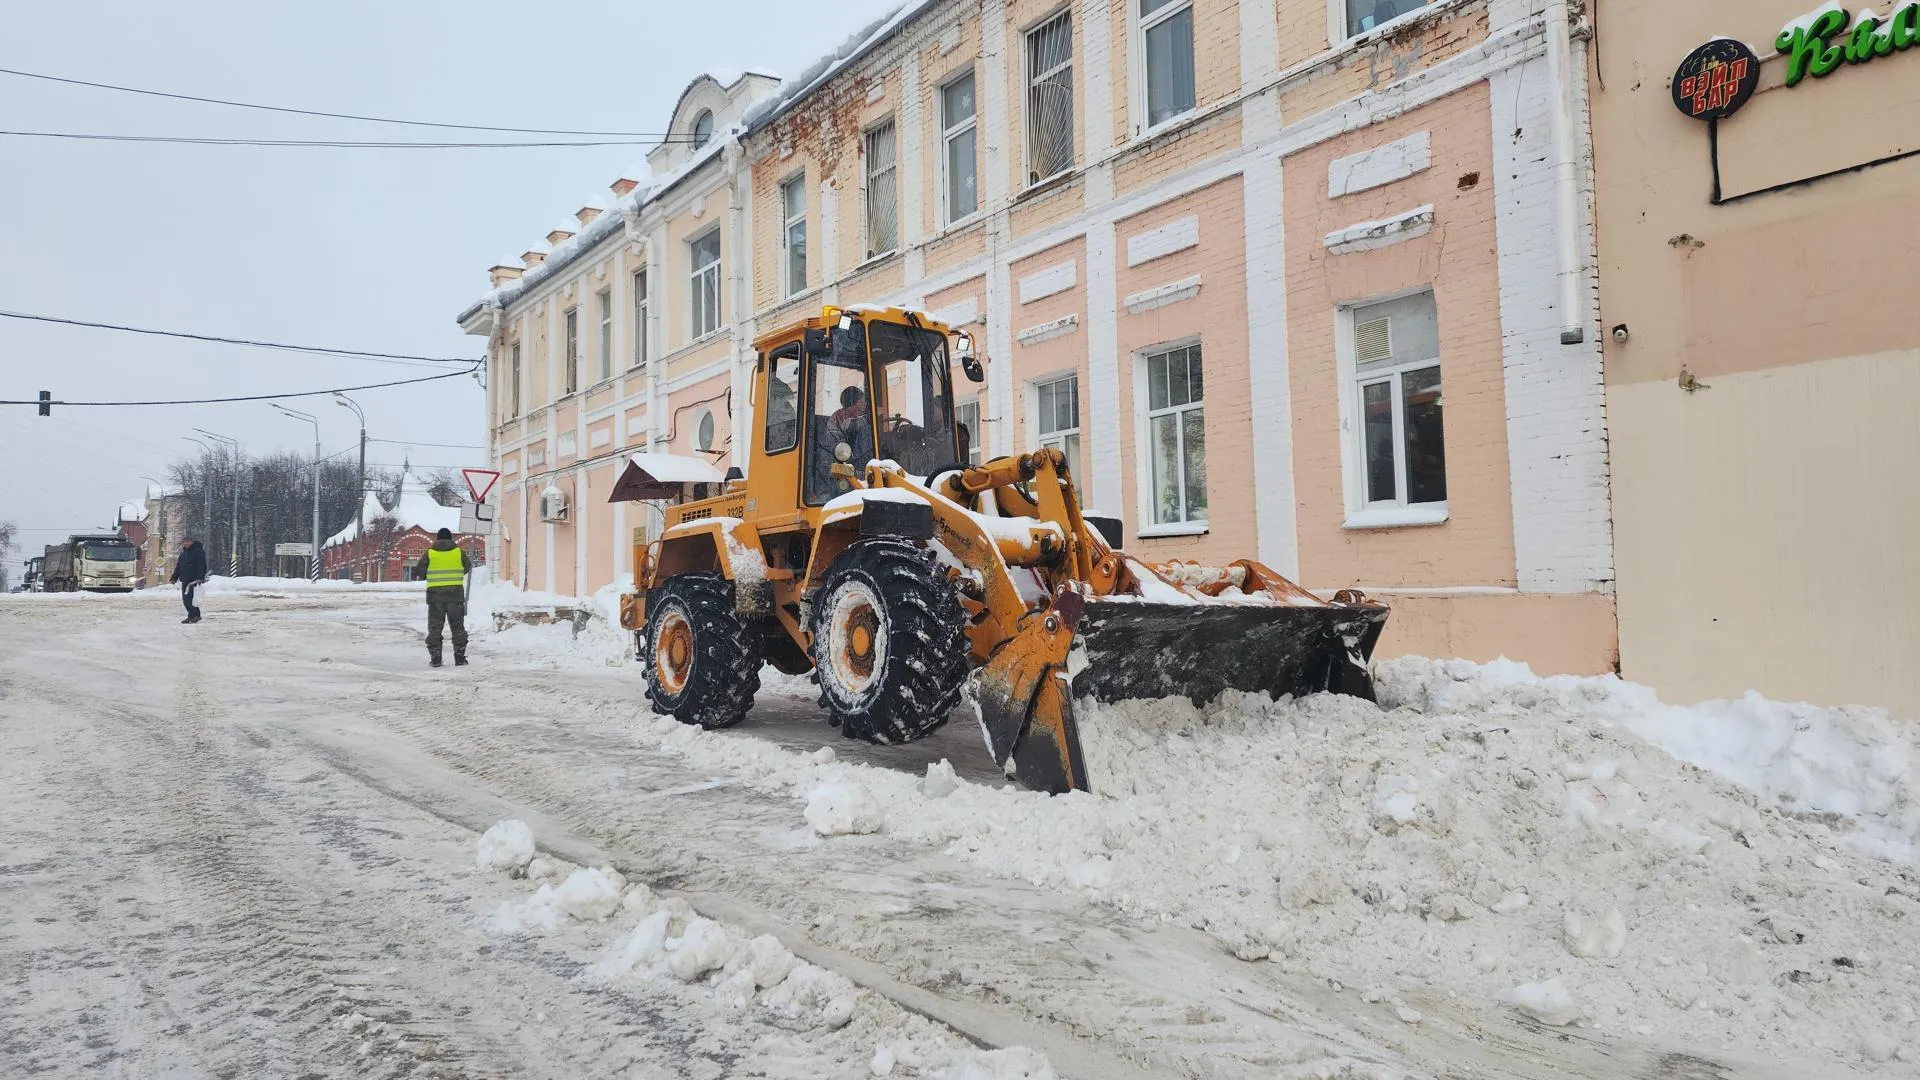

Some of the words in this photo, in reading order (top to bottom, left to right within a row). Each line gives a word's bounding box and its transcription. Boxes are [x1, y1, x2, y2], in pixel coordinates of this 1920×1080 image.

[1775, 3, 1920, 88] Кал
[1681, 57, 1748, 99] ВЭЙП
[1692, 80, 1738, 115] БАР
